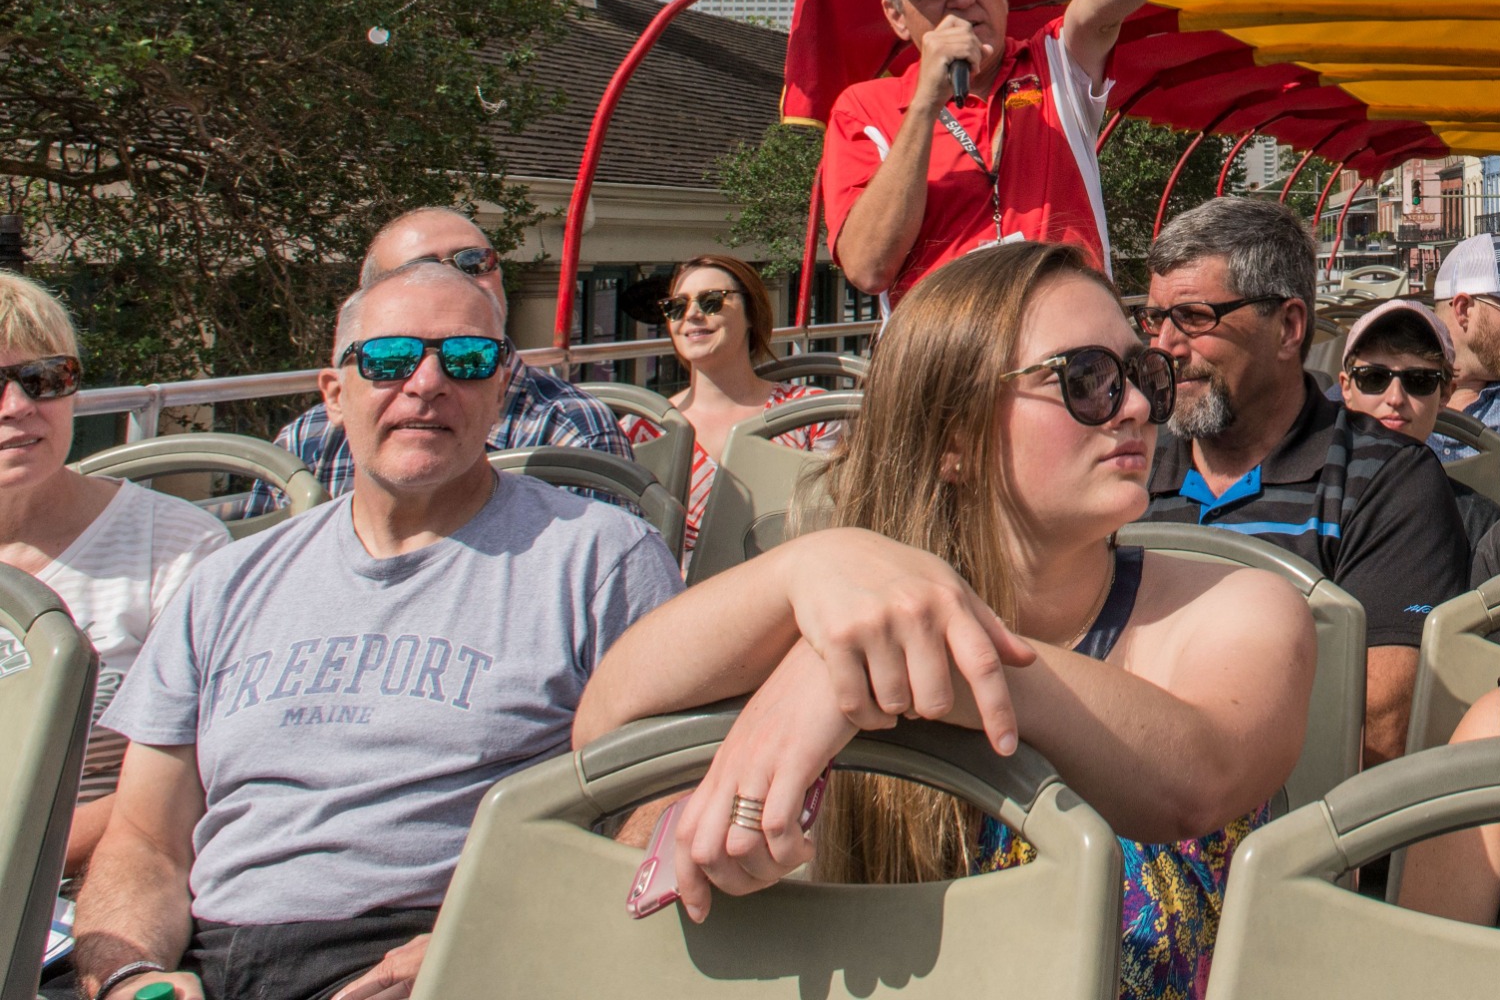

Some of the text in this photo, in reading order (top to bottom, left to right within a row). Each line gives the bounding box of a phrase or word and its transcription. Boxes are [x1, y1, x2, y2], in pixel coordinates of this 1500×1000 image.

[946, 121, 976, 152] SAINTS
[202, 633, 494, 735] FREEPORT
[279, 704, 375, 727] MAINE
